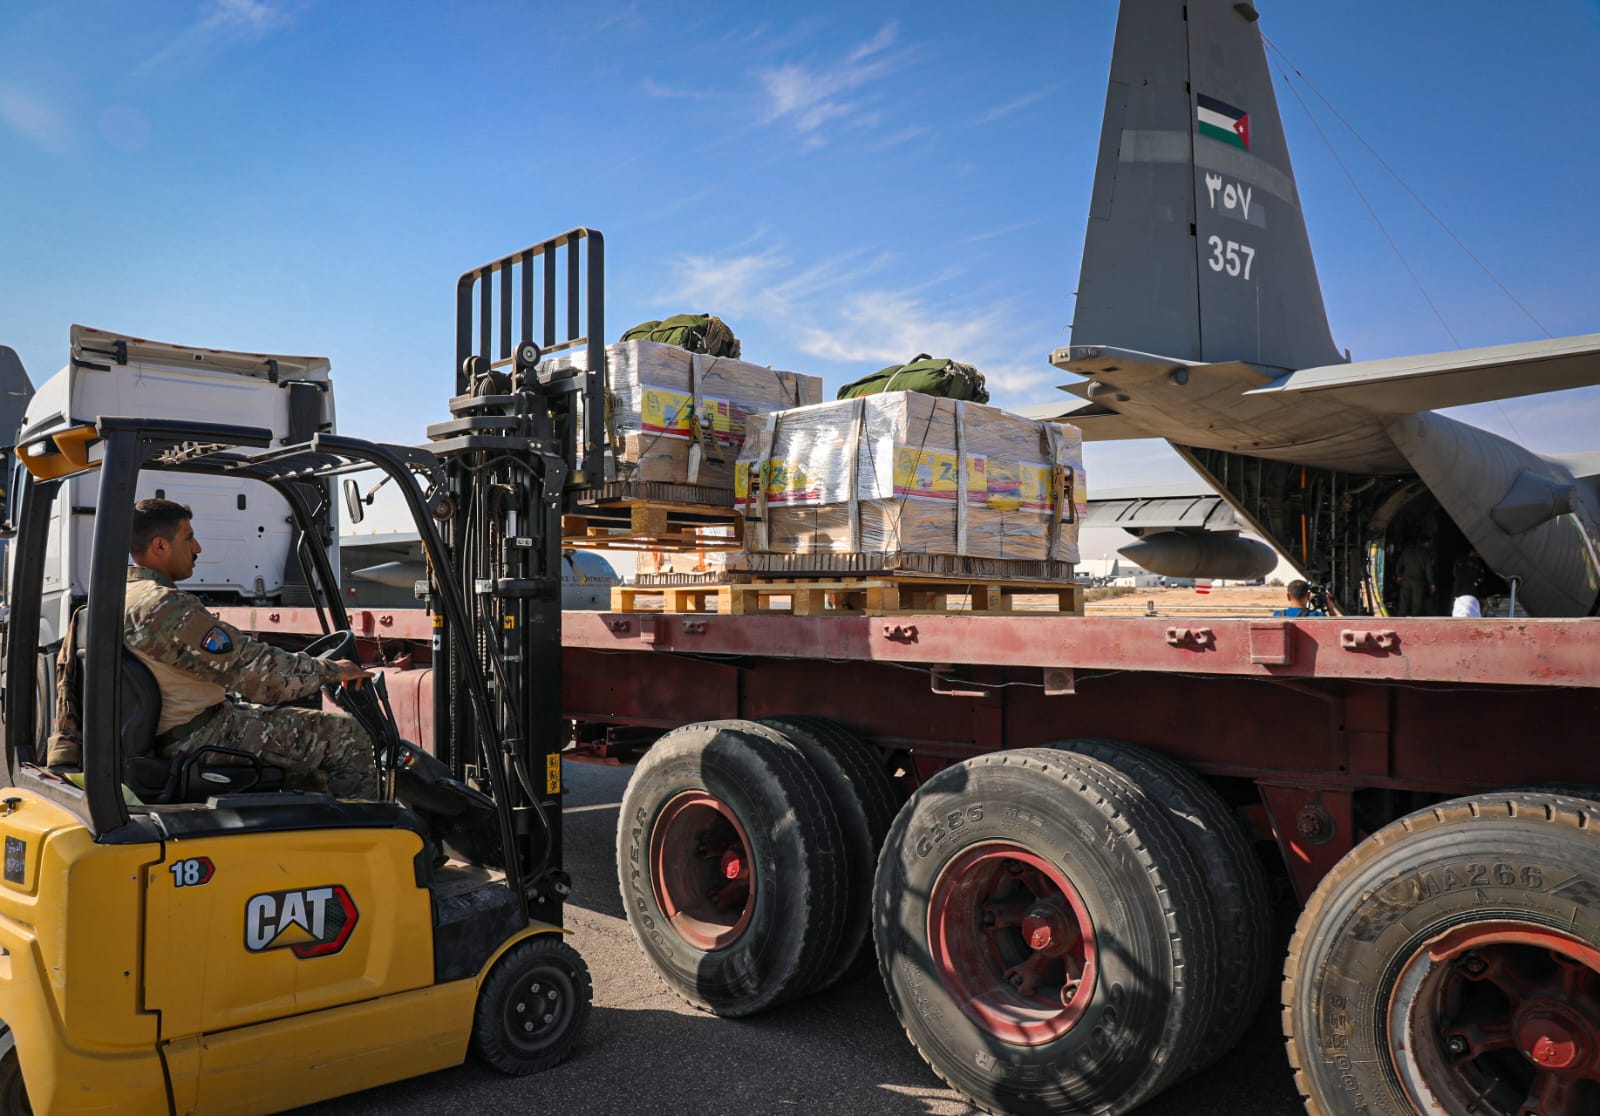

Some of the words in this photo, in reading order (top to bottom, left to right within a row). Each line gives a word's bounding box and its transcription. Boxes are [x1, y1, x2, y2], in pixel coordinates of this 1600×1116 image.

[1205, 172, 1251, 220] ٣٥٧
[1208, 235, 1255, 281] 357
[916, 802, 984, 858] G386
[171, 859, 200, 887] 18
[247, 887, 333, 951] CAT
